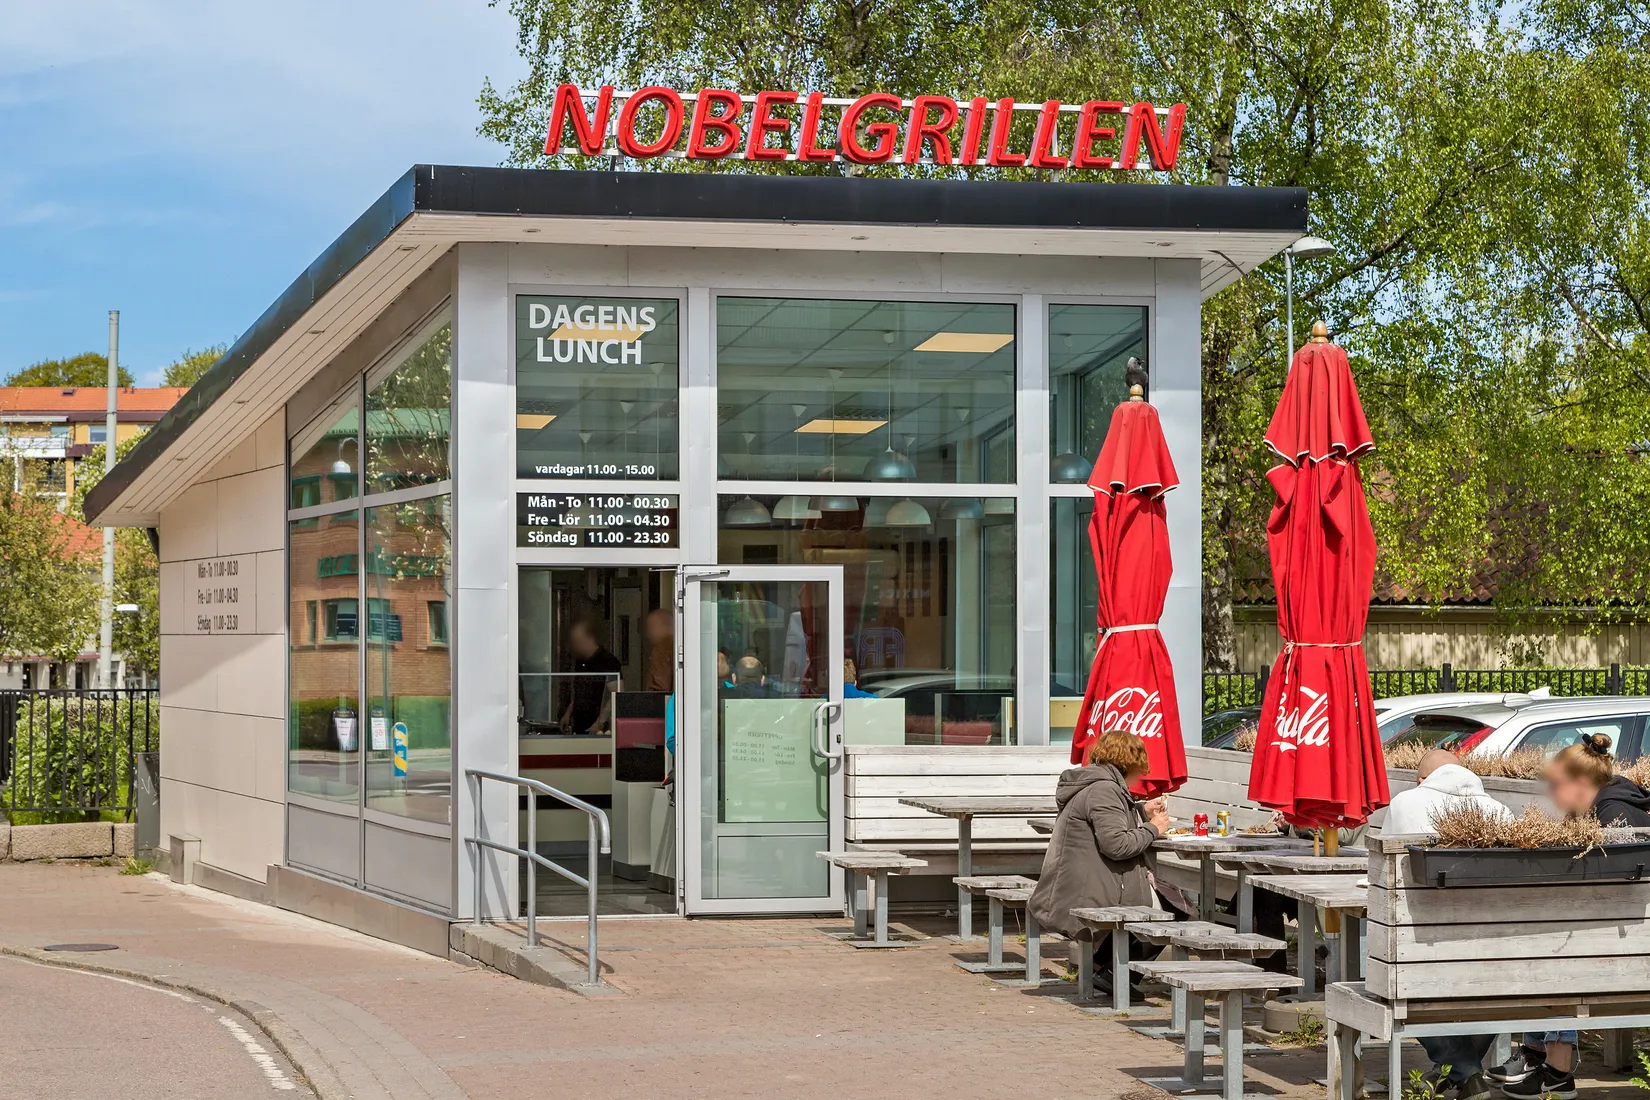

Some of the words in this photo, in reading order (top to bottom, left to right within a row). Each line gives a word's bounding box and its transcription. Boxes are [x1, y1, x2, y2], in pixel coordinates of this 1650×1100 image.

[544, 84, 1187, 170] NOBELGRILLEN
[529, 304, 656, 332] DAGENS
[537, 337, 641, 364] LUNCH
[536, 465, 584, 476] vardagar
[587, 465, 616, 475] 11.00
[626, 465, 654, 475] 15.00
[528, 496, 556, 508] Mån
[566, 496, 581, 508] To
[588, 497, 623, 508] 11.00
[634, 497, 669, 509] 00.30
[528, 514, 548, 525] Fre
[559, 513, 579, 525] Lör
[588, 514, 623, 525] 11.00
[634, 514, 669, 526] 04.30
[528, 530, 577, 545] Söndag
[588, 532, 623, 543] 11.00
[634, 532, 669, 544] 23.30
[214, 562, 224, 577] 11.00
[227, 560, 238, 576] 00.30
[214, 588, 224, 603] 11.00
[227, 588, 238, 603] 04.30
[214, 616, 224, 630] 11.00
[227, 615, 238, 630] 23.30
